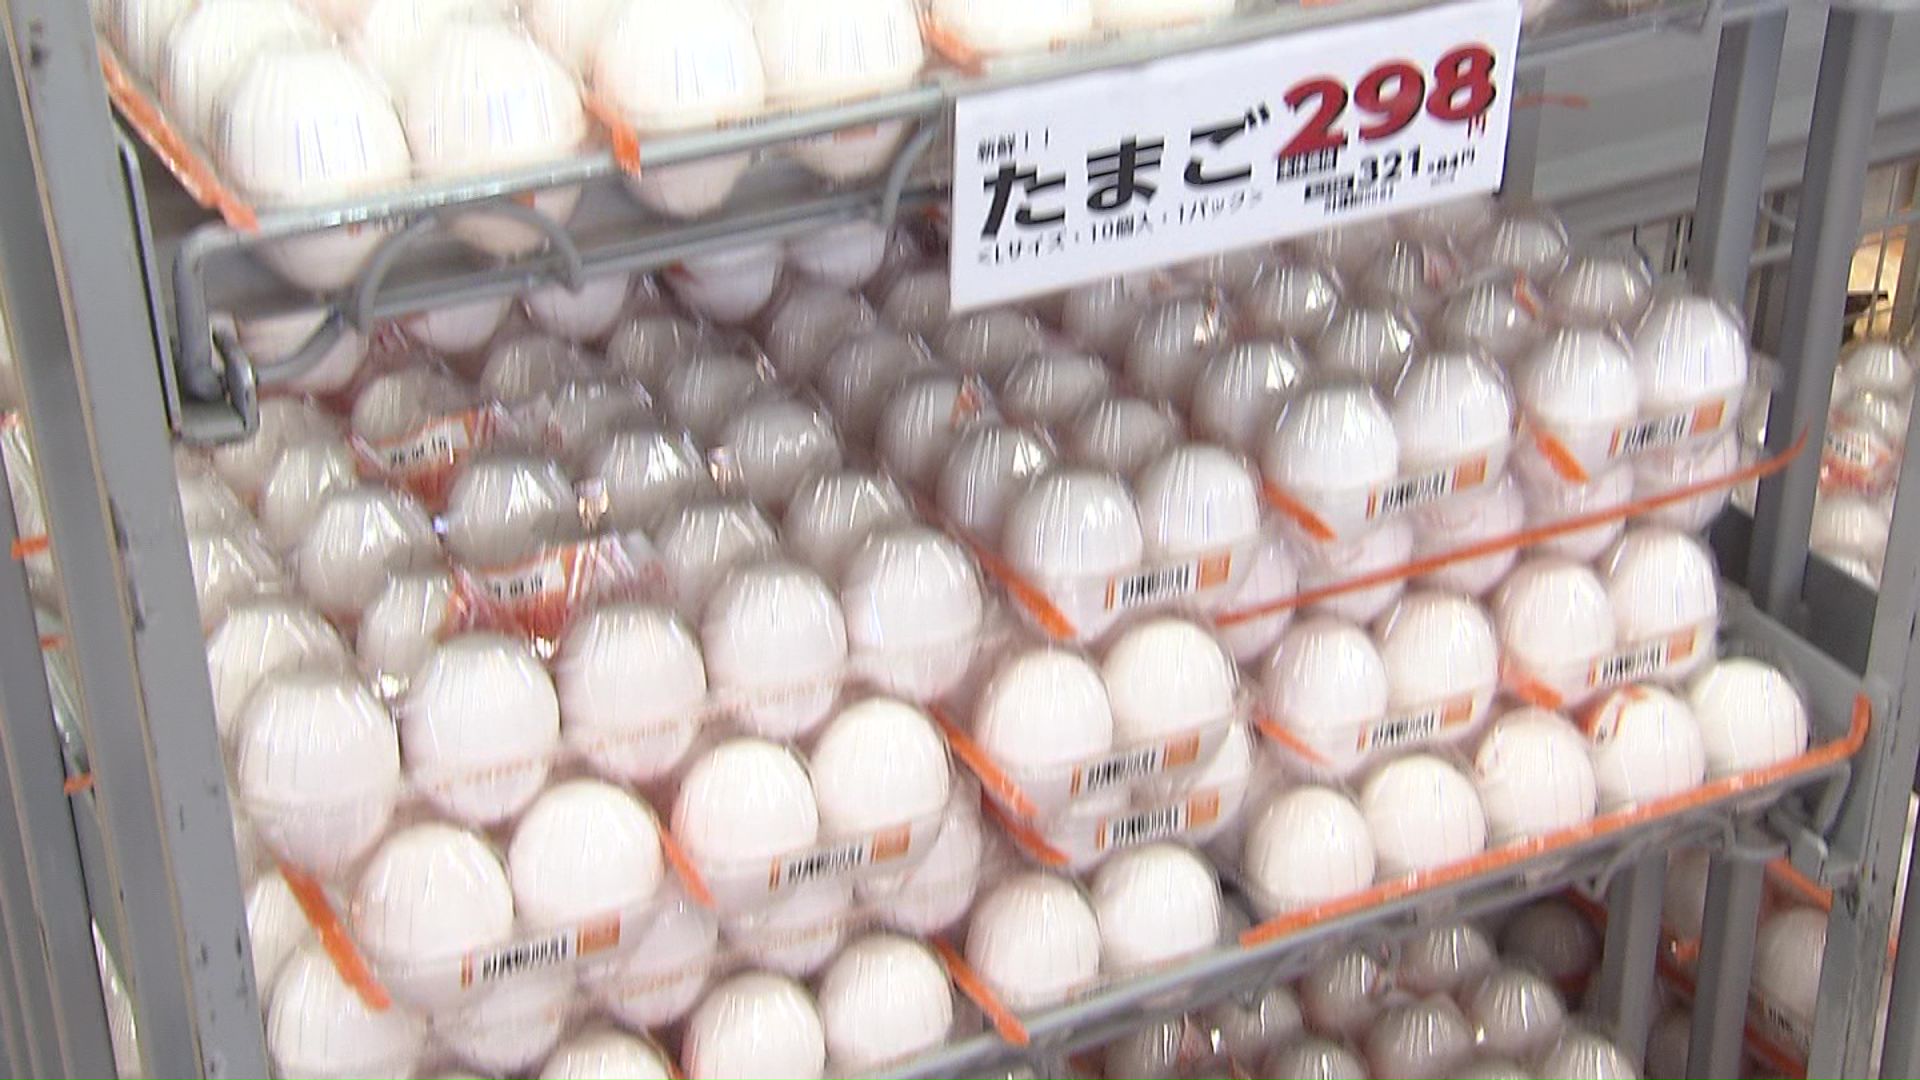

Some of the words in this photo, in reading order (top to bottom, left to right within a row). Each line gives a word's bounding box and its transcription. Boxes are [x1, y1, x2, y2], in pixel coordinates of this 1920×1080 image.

[1276, 43, 1496, 159] 298
[980, 101, 1270, 239] たまご
